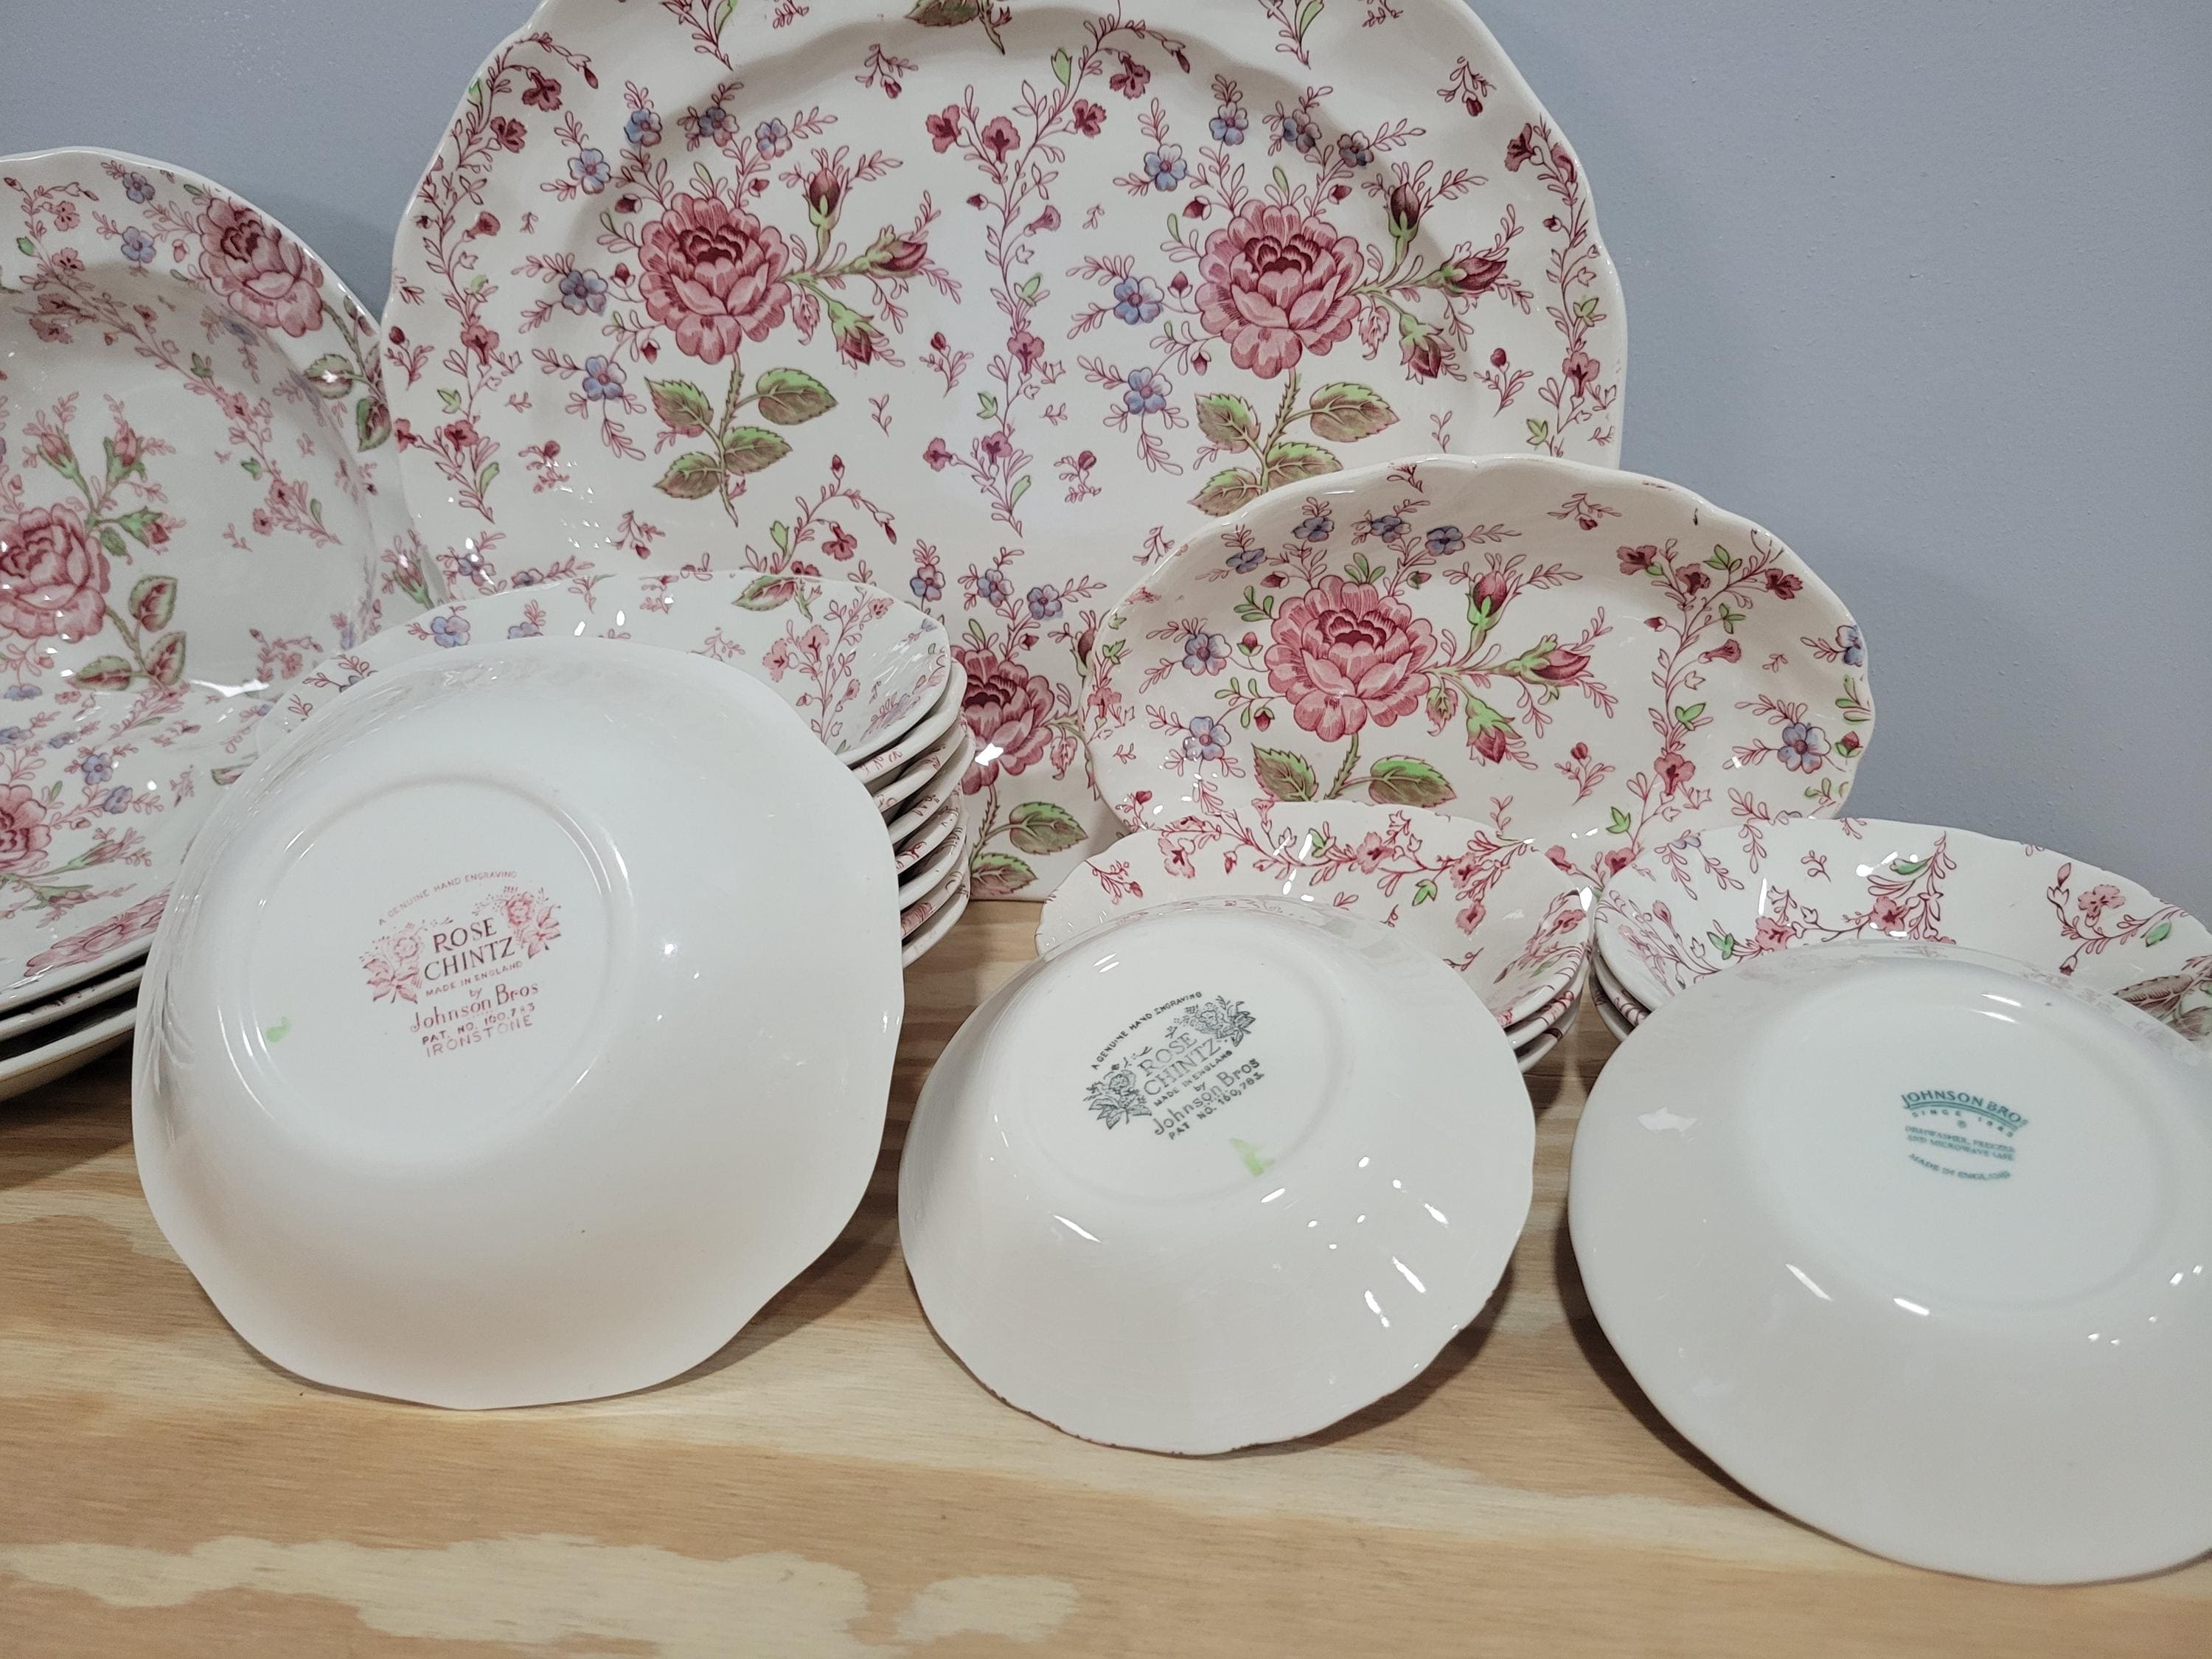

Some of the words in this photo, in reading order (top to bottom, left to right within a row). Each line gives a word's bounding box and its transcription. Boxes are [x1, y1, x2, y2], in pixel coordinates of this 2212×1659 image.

[387, 889, 430, 919] GENUINE
[434, 877, 462, 892] HAND
[465, 870, 518, 883] ENGRAVING
[433, 917, 497, 953] ROSE
[424, 936, 515, 981] CHINTZ
[425, 981, 457, 997] MADE
[461, 977, 472, 987] IN
[475, 961, 524, 982] ENGLAND
[410, 998, 492, 1032] Johnson
[495, 983, 539, 1006] Bros
[469, 987, 482, 1000] by
[426, 1015, 533, 1058] IRONSTONE
[1096, 1031, 1128, 1062] GENUINE
[1130, 1013, 1152, 1031] HAND
[1154, 991, 1203, 1015] ENGRAVING
[1138, 1032, 1197, 1077] ROSE
[1144, 1038, 1221, 1095] CHINTZ
[1153, 1088, 1180, 1107] MADE
[1183, 1079, 1192, 1088] IN
[1192, 1050, 1233, 1081] ENGLAND
[1153, 1083, 1221, 1135] Johnson
[1216, 1058, 1260, 1087] Bros
[1194, 1082, 1206, 1092] by
[1902, 1090, 1983, 1109] JOHNSON
[1909, 1153, 1940, 1172] MADE
